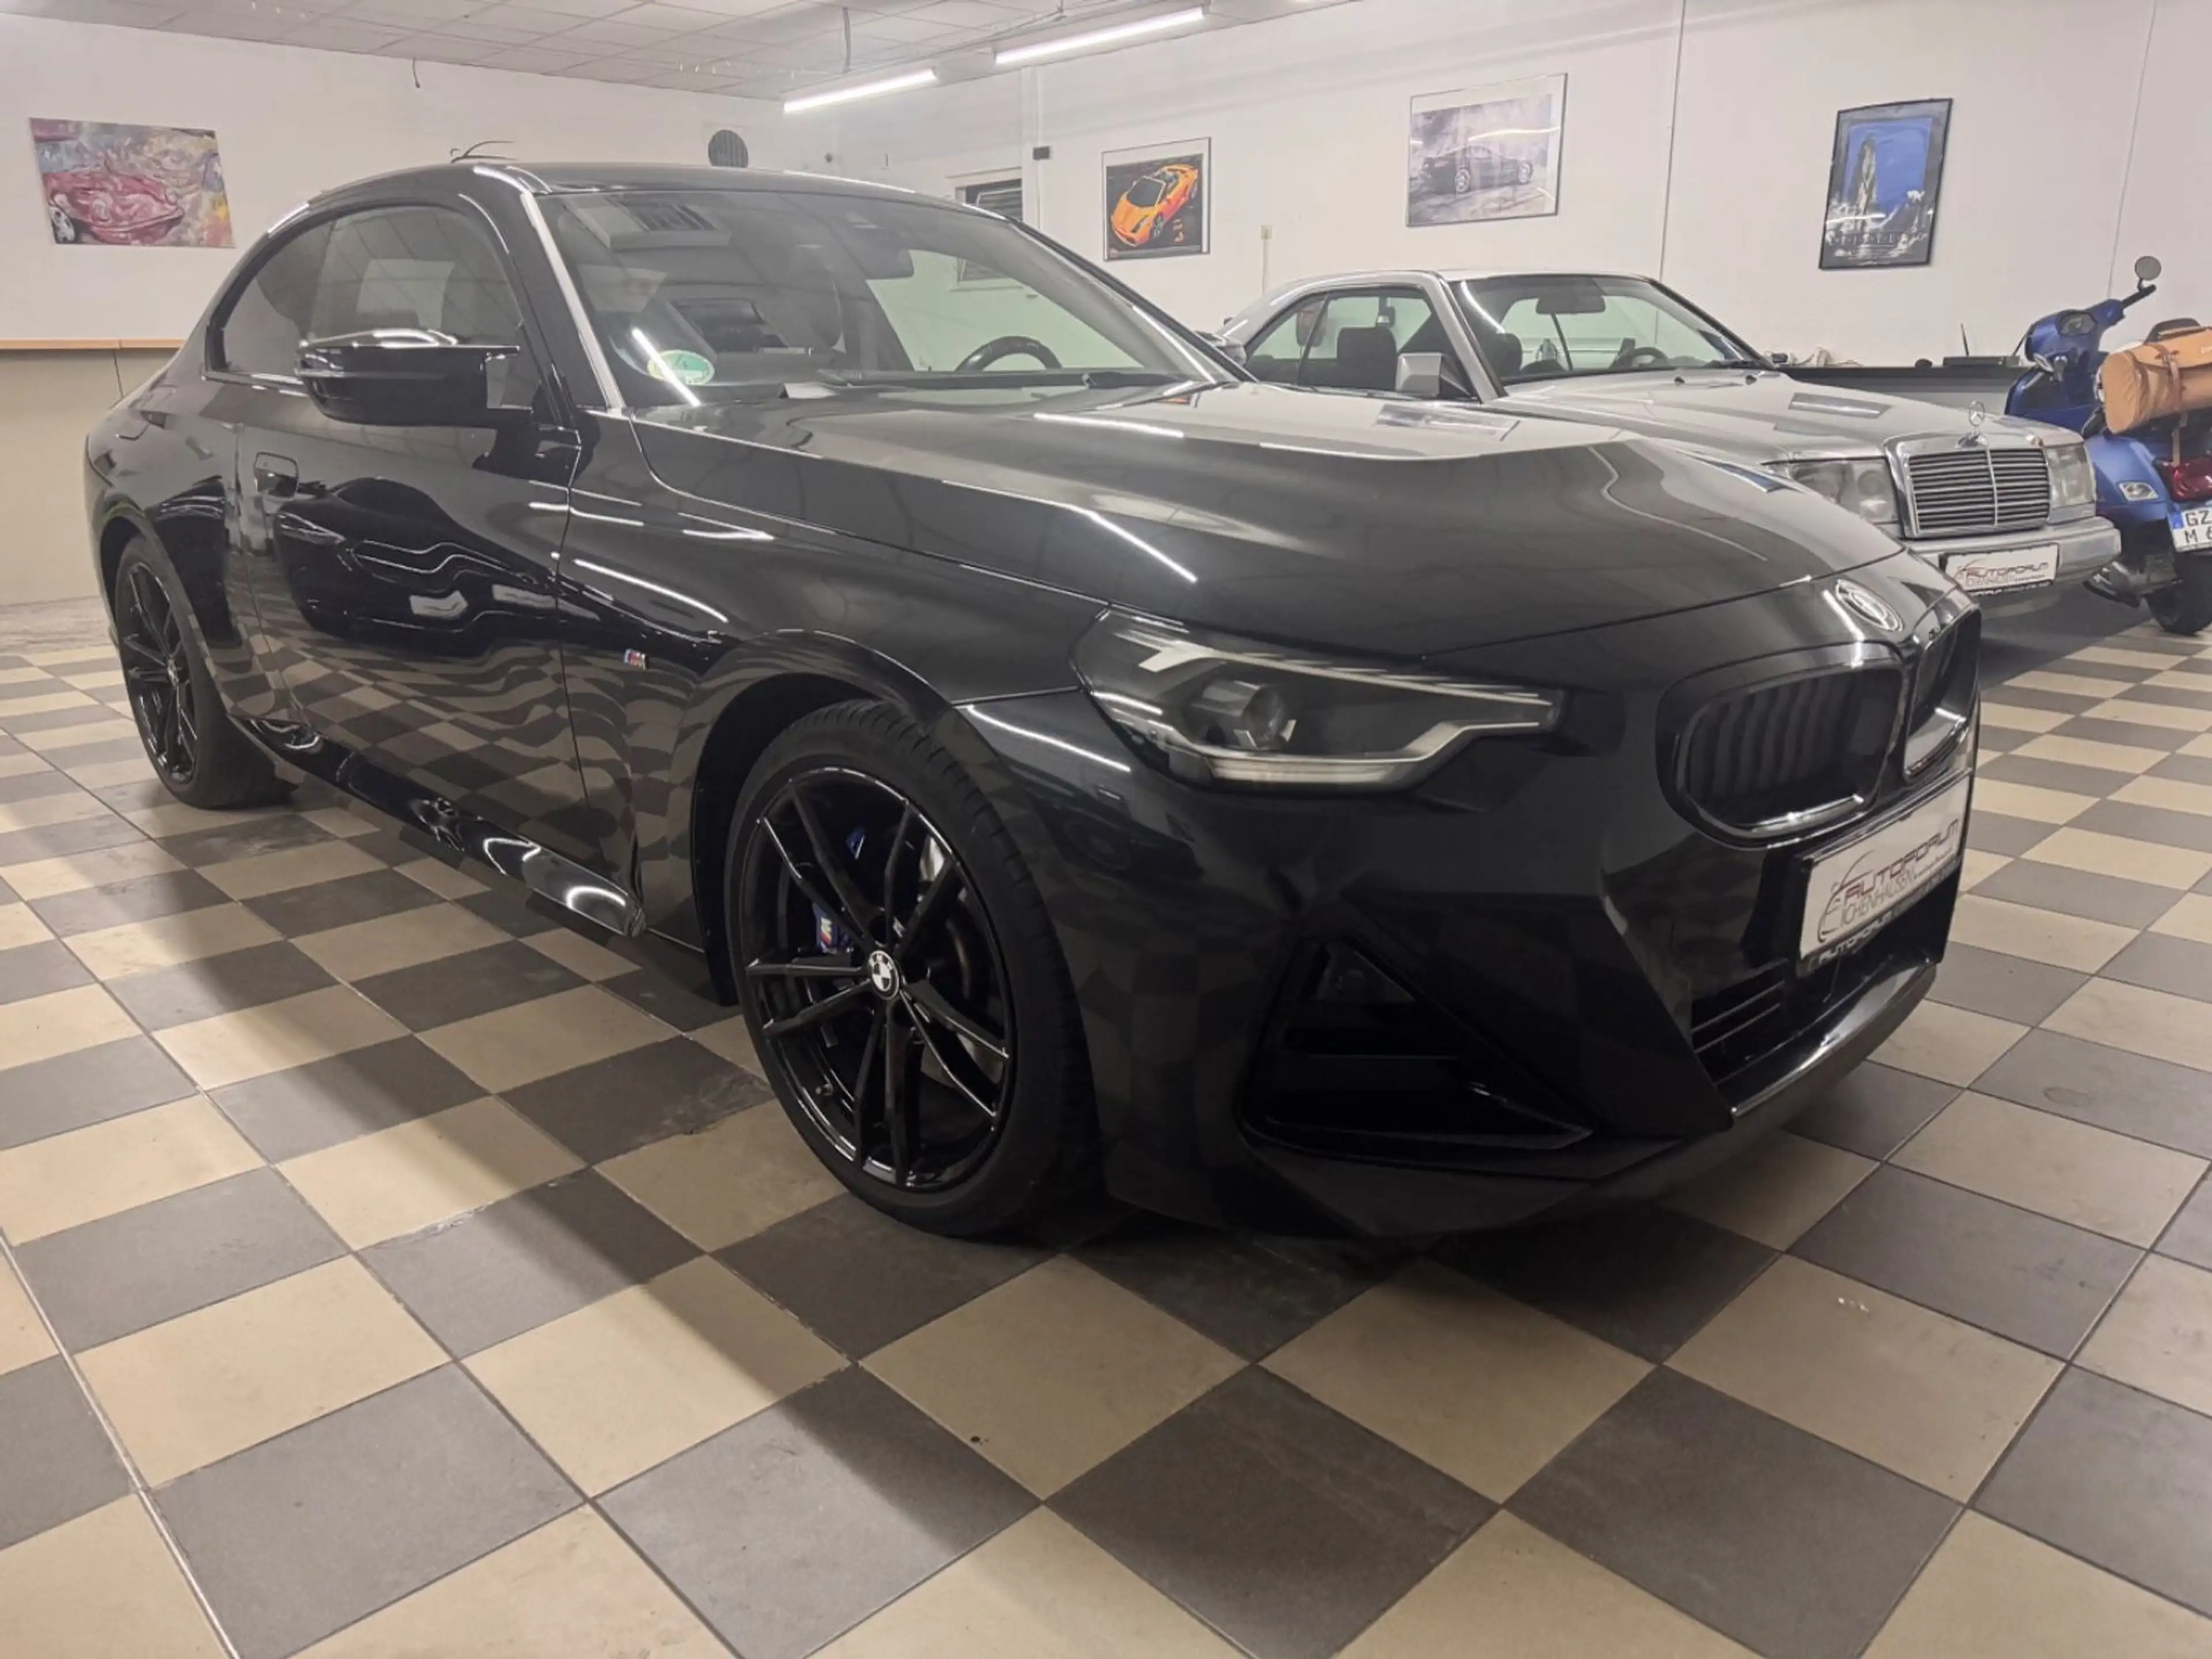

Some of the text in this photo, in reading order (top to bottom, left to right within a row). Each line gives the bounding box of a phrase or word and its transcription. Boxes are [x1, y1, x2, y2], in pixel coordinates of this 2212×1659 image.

[2186, 511, 2212, 527] GZ
[2184, 529, 2198, 543] M
[1844, 818, 1958, 905] AUTOFORUM
